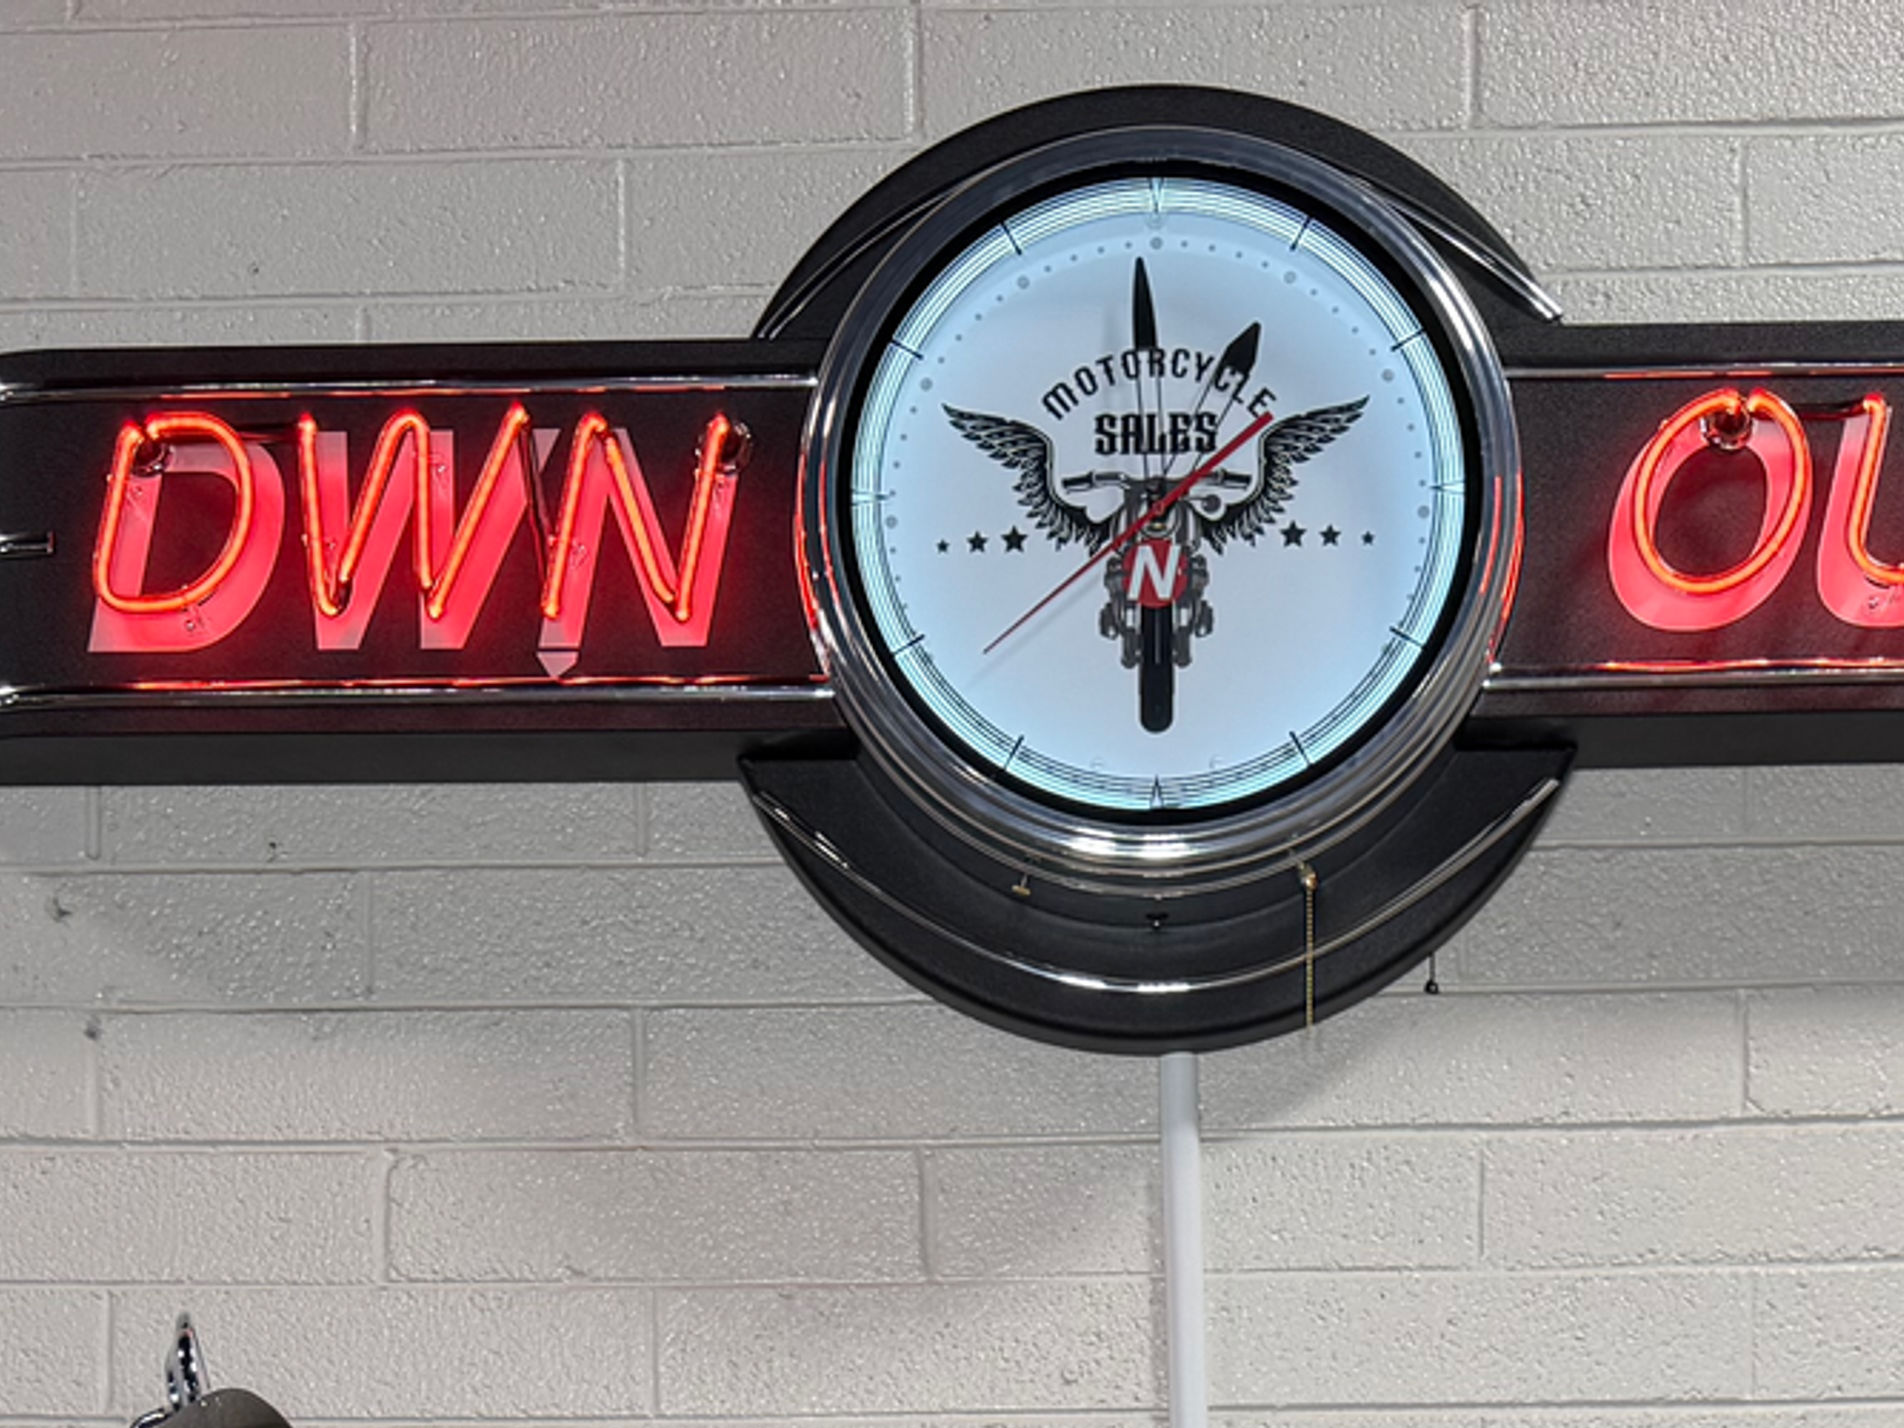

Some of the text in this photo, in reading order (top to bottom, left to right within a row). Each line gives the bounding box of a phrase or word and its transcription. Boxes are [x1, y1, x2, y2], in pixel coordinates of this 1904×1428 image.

[1042, 348, 1277, 419] MOTORCYCLE
[1094, 412, 1217, 455] SALES
[89, 409, 738, 652] DWN
[1127, 545, 1182, 600] N
